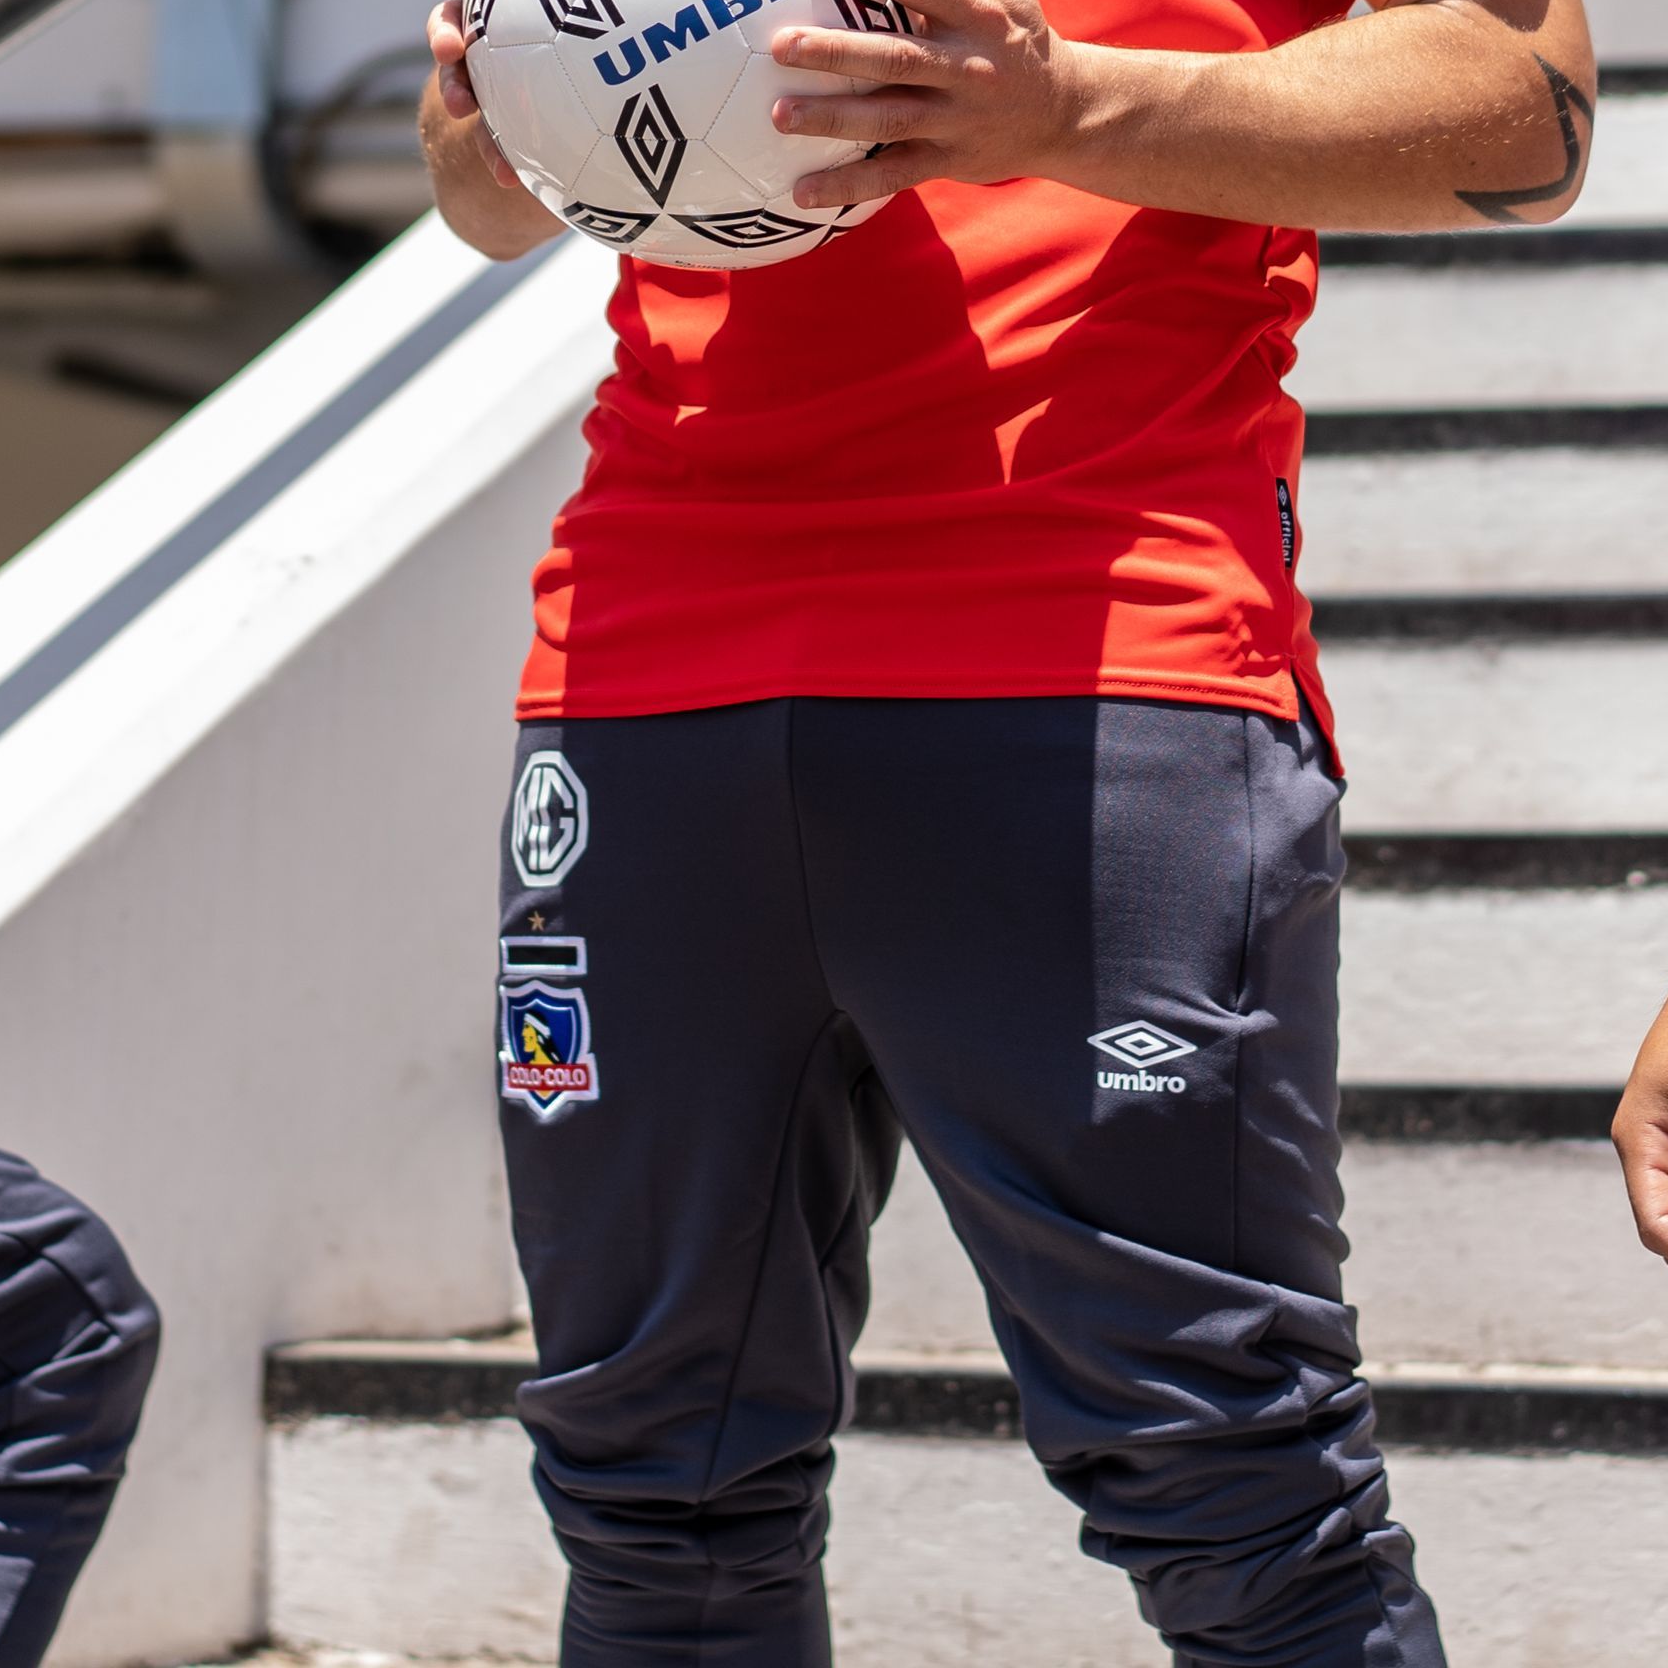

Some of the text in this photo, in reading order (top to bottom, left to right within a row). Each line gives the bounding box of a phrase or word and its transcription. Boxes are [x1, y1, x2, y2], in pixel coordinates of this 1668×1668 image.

[516, 767, 575, 871] MG
[511, 1066, 587, 1086] COLO-COLO
[1097, 1070, 1187, 1095] umbro
